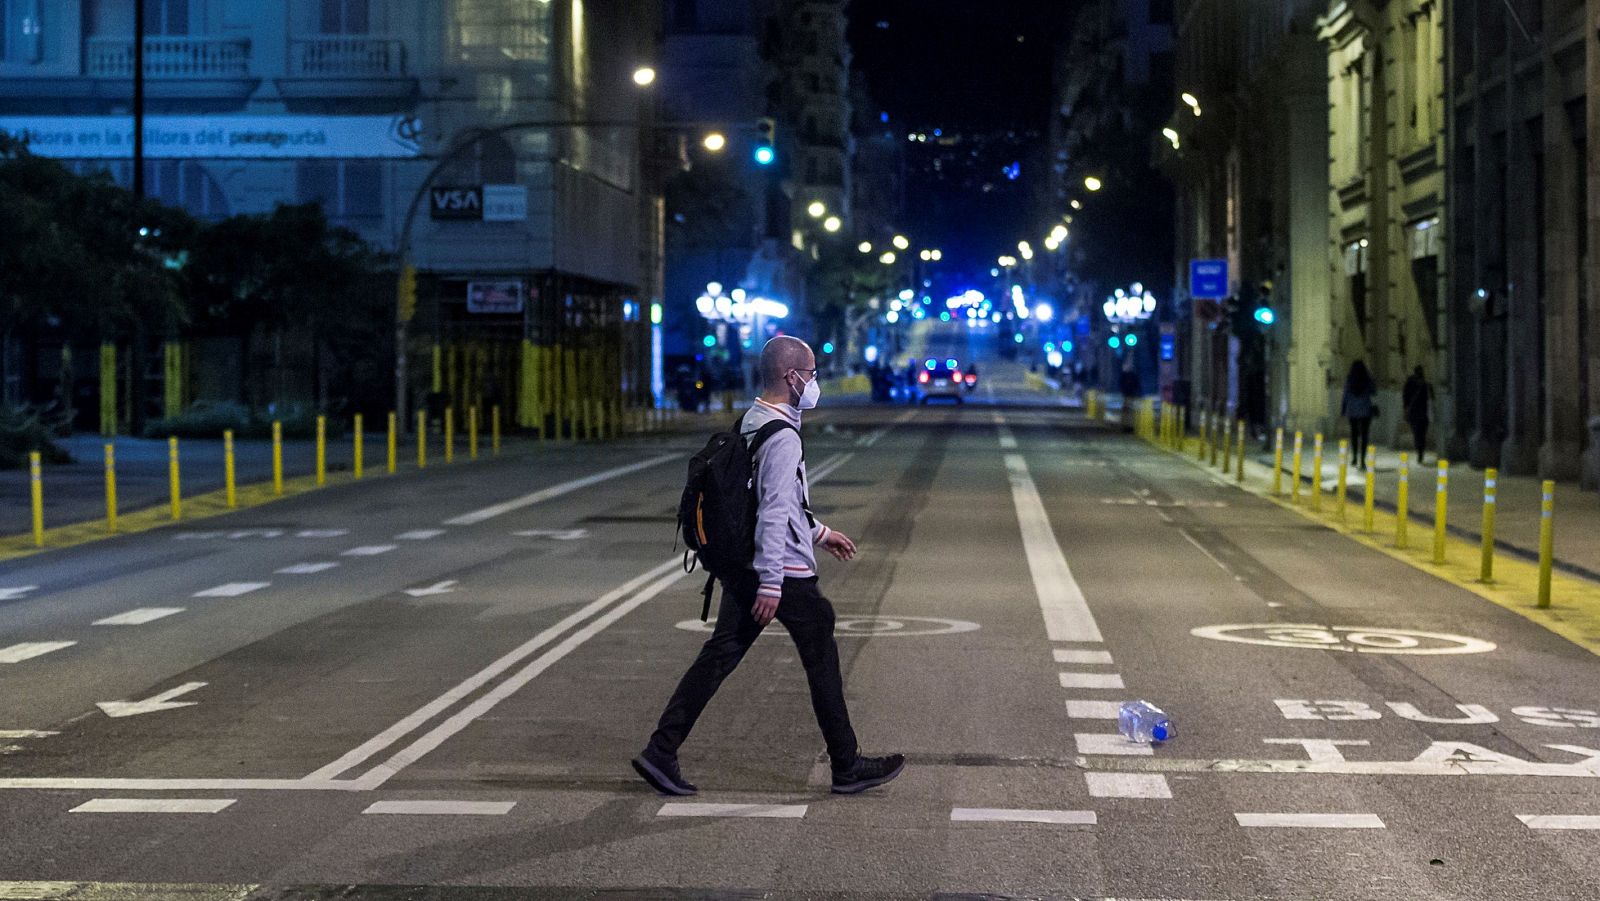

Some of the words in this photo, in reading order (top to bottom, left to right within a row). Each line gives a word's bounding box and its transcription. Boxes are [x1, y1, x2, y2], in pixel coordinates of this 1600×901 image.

[195, 128, 223, 146] del
[1263, 627, 1419, 648] 30
[1273, 698, 1600, 728] BUS
